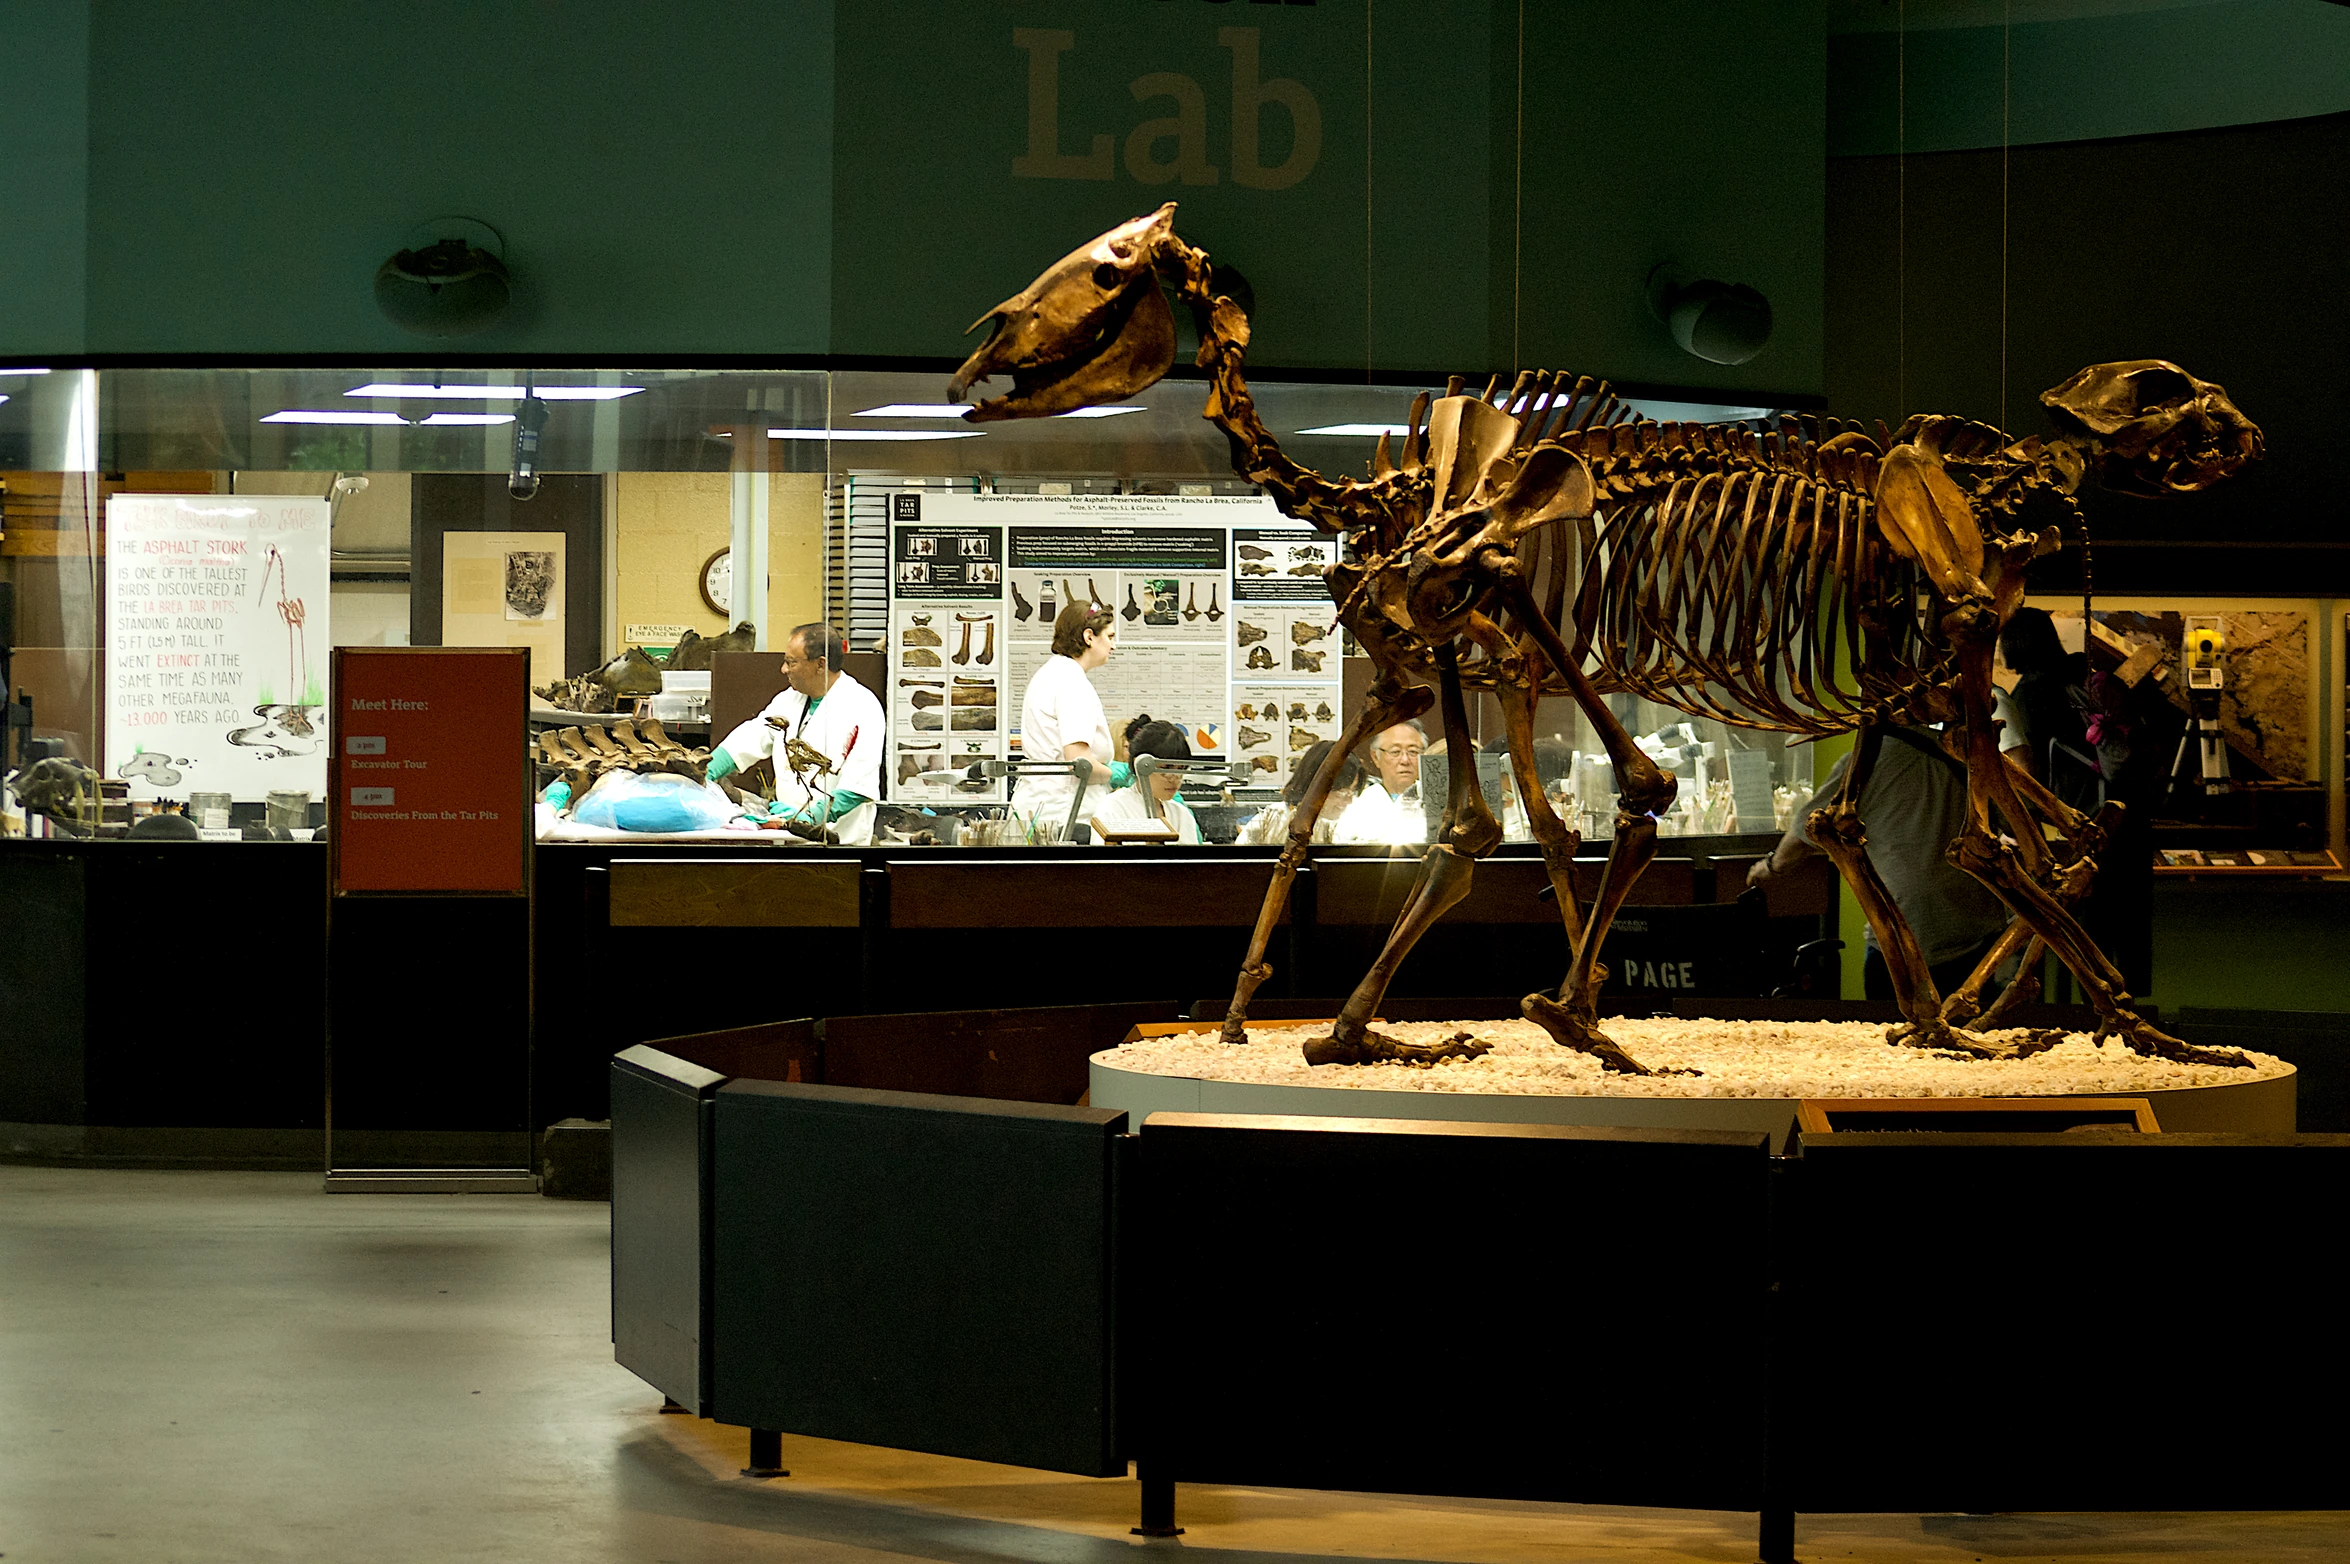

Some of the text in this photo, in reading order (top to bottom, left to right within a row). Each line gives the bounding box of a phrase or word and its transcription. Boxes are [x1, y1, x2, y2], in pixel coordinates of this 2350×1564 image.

[1011, 25, 1323, 190] Lab
[1084, 496, 1141, 504] Asphalt-Preserved
[117, 540, 248, 555] THE ASPHALT STORK
[118, 567, 248, 581] IS ONE OF THE TALLEST
[118, 583, 248, 597] BIRDS DISCOVERED AT
[118, 600, 238, 614] THE LA BREA TAR PITS.
[118, 617, 223, 630] STANDING AROUND
[118, 636, 126, 650] 5
[130, 635, 142, 649] FT
[181, 634, 208, 648] TALL.
[215, 634, 224, 647] IT
[118, 654, 240, 668] WENT EXTINCT AT THE
[118, 671, 243, 689] SAME TIME AS MANY
[118, 691, 234, 708] OTHER MEGAFAUNA.
[351, 698, 429, 711] Meet Here:
[174, 709, 208, 725] YEARS
[215, 709, 242, 724] AGO.
[351, 759, 428, 769] Excavator Tour
[351, 810, 499, 820] Discoveries From the Tar Pits
[1624, 958, 1697, 989] PAGE
